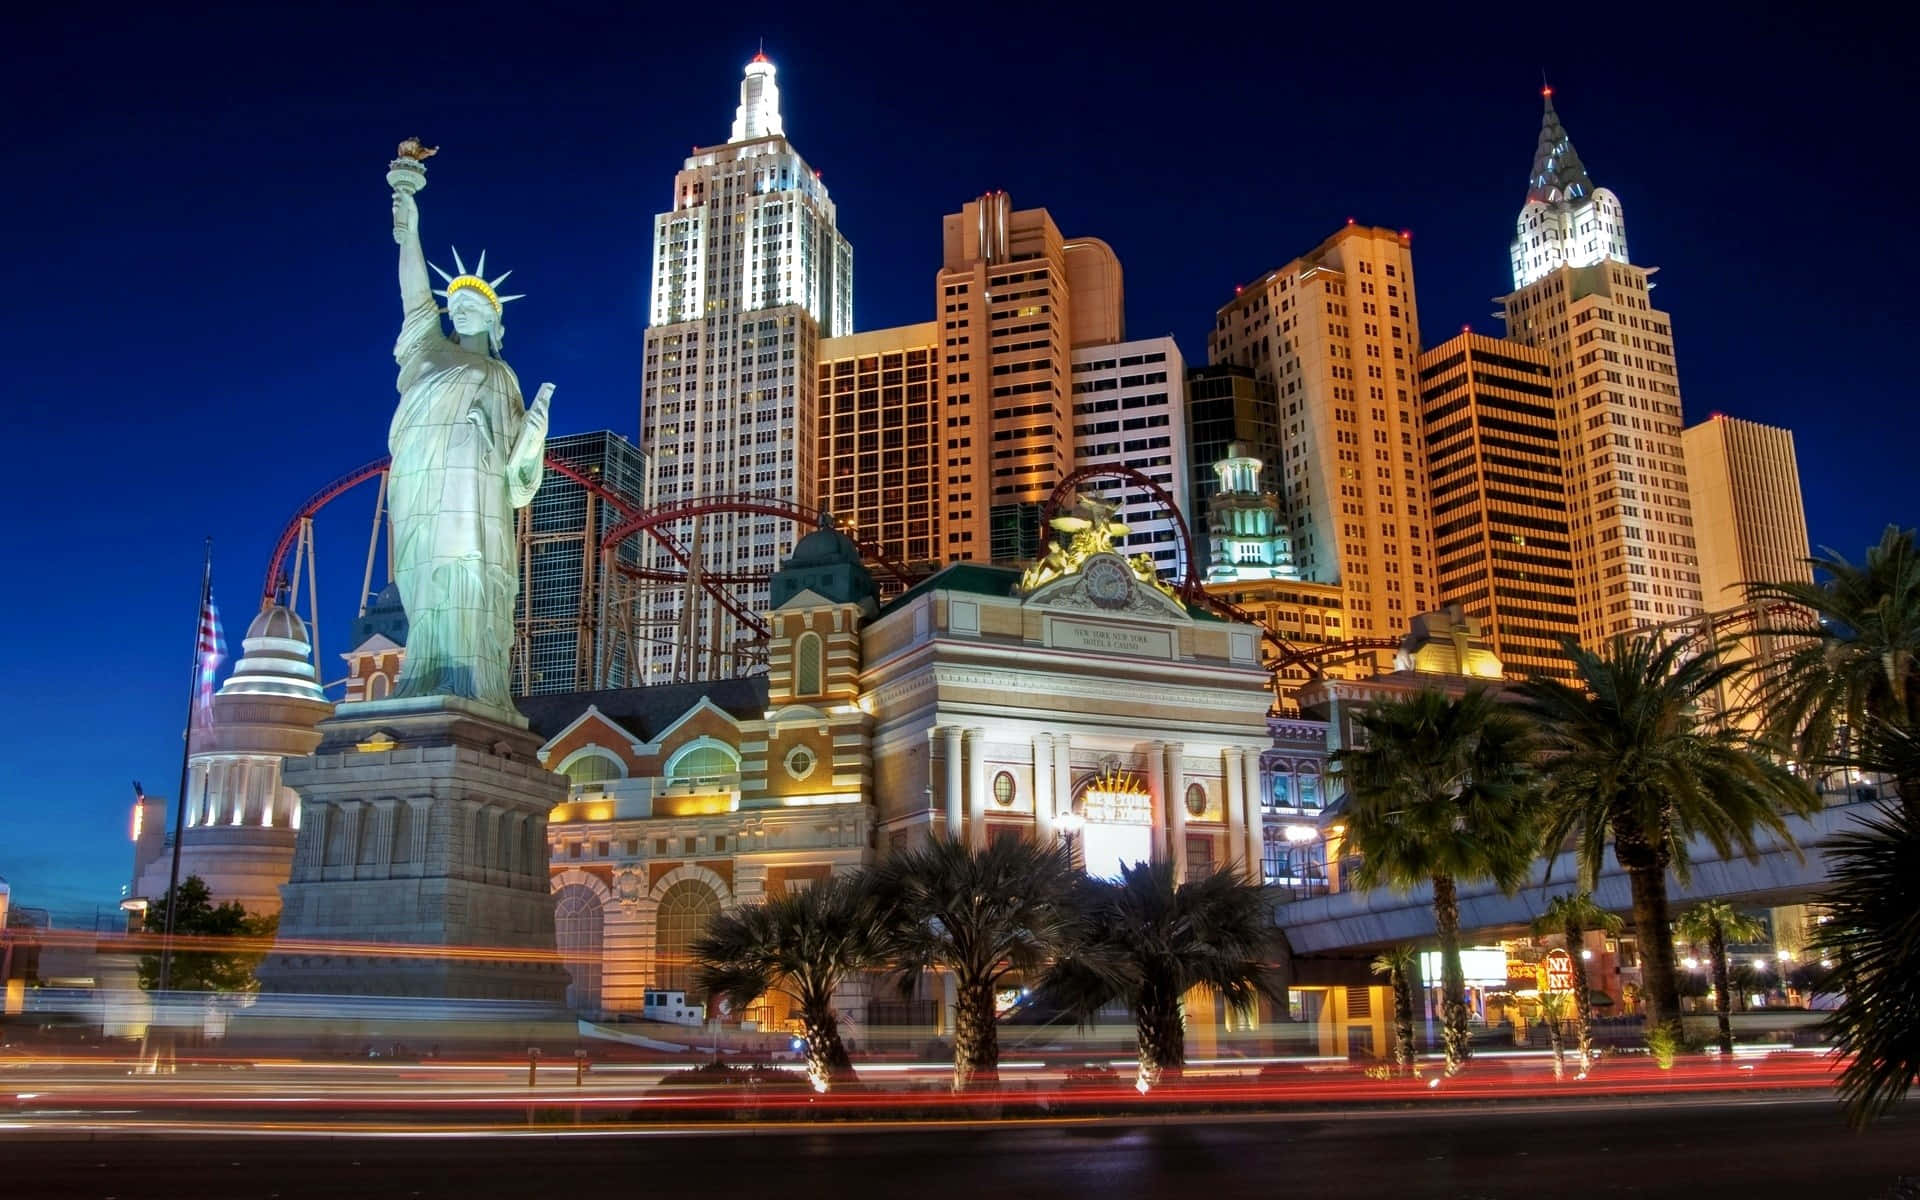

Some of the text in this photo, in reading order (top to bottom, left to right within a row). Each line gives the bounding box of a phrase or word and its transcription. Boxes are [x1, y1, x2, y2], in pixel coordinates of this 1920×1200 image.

[1074, 629, 1089, 637] NEW
[1093, 631, 1111, 640] YORK
[1130, 634, 1148, 644] YORK
[1083, 638, 1104, 648] HOTEL
[1114, 641, 1139, 649] CASINO
[1549, 957, 1569, 972] NY
[1550, 973, 1570, 988] NY
